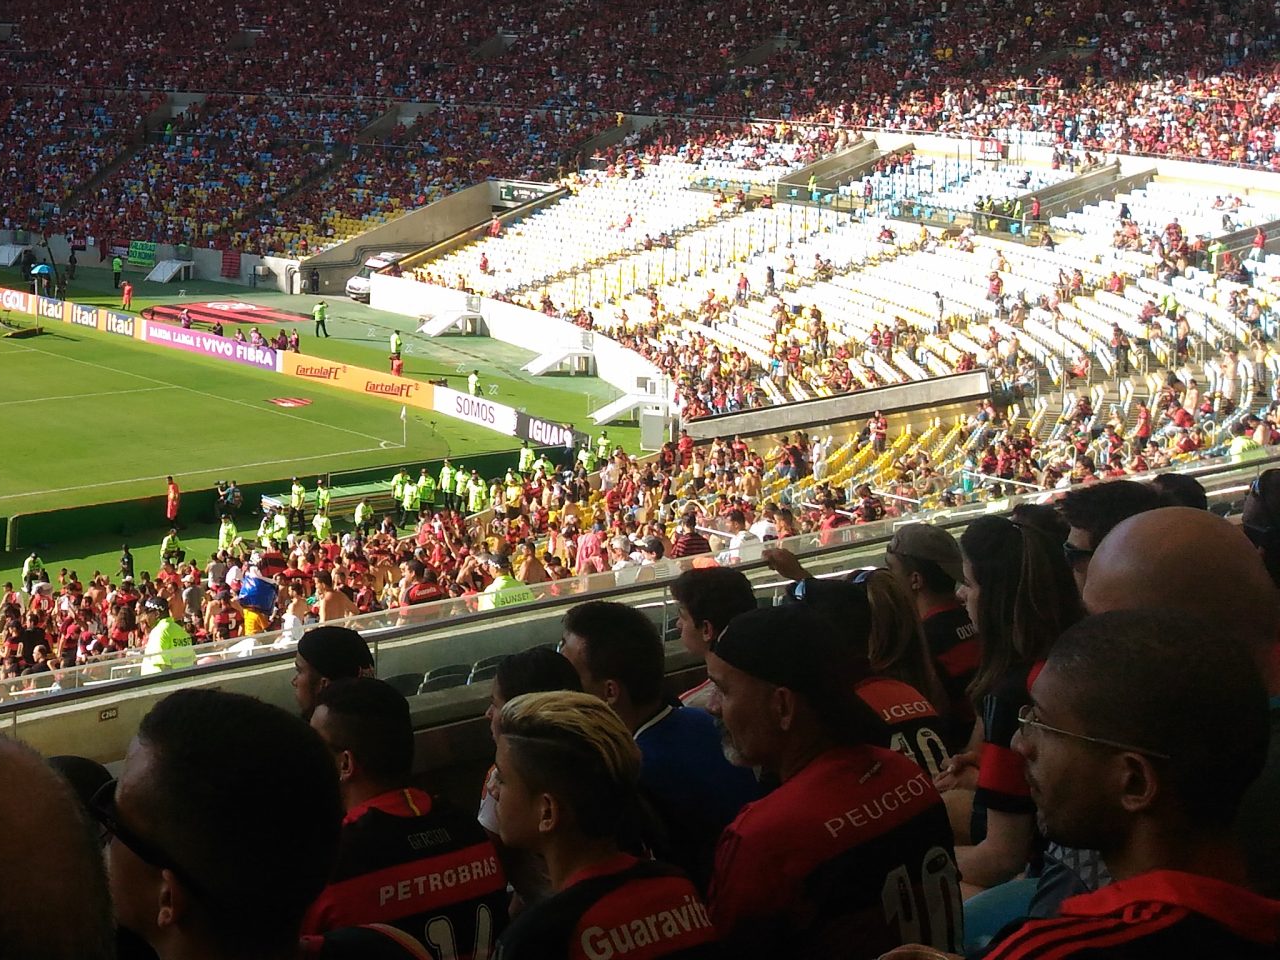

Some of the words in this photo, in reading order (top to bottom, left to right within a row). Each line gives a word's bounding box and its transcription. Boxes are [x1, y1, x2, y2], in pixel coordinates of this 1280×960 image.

[2, 289, 27, 311] GOL
[39, 295, 63, 319] Itaú
[73, 304, 97, 328] Itaú
[108, 313, 133, 336] Itaú
[202, 336, 233, 356] VIVO
[236, 344, 273, 366] FIBRA
[455, 395, 496, 424] SOMOS
[500, 592, 529, 606] SUNSET
[824, 772, 932, 838] PEUGEOT
[379, 856, 497, 907] PETROBRAS
